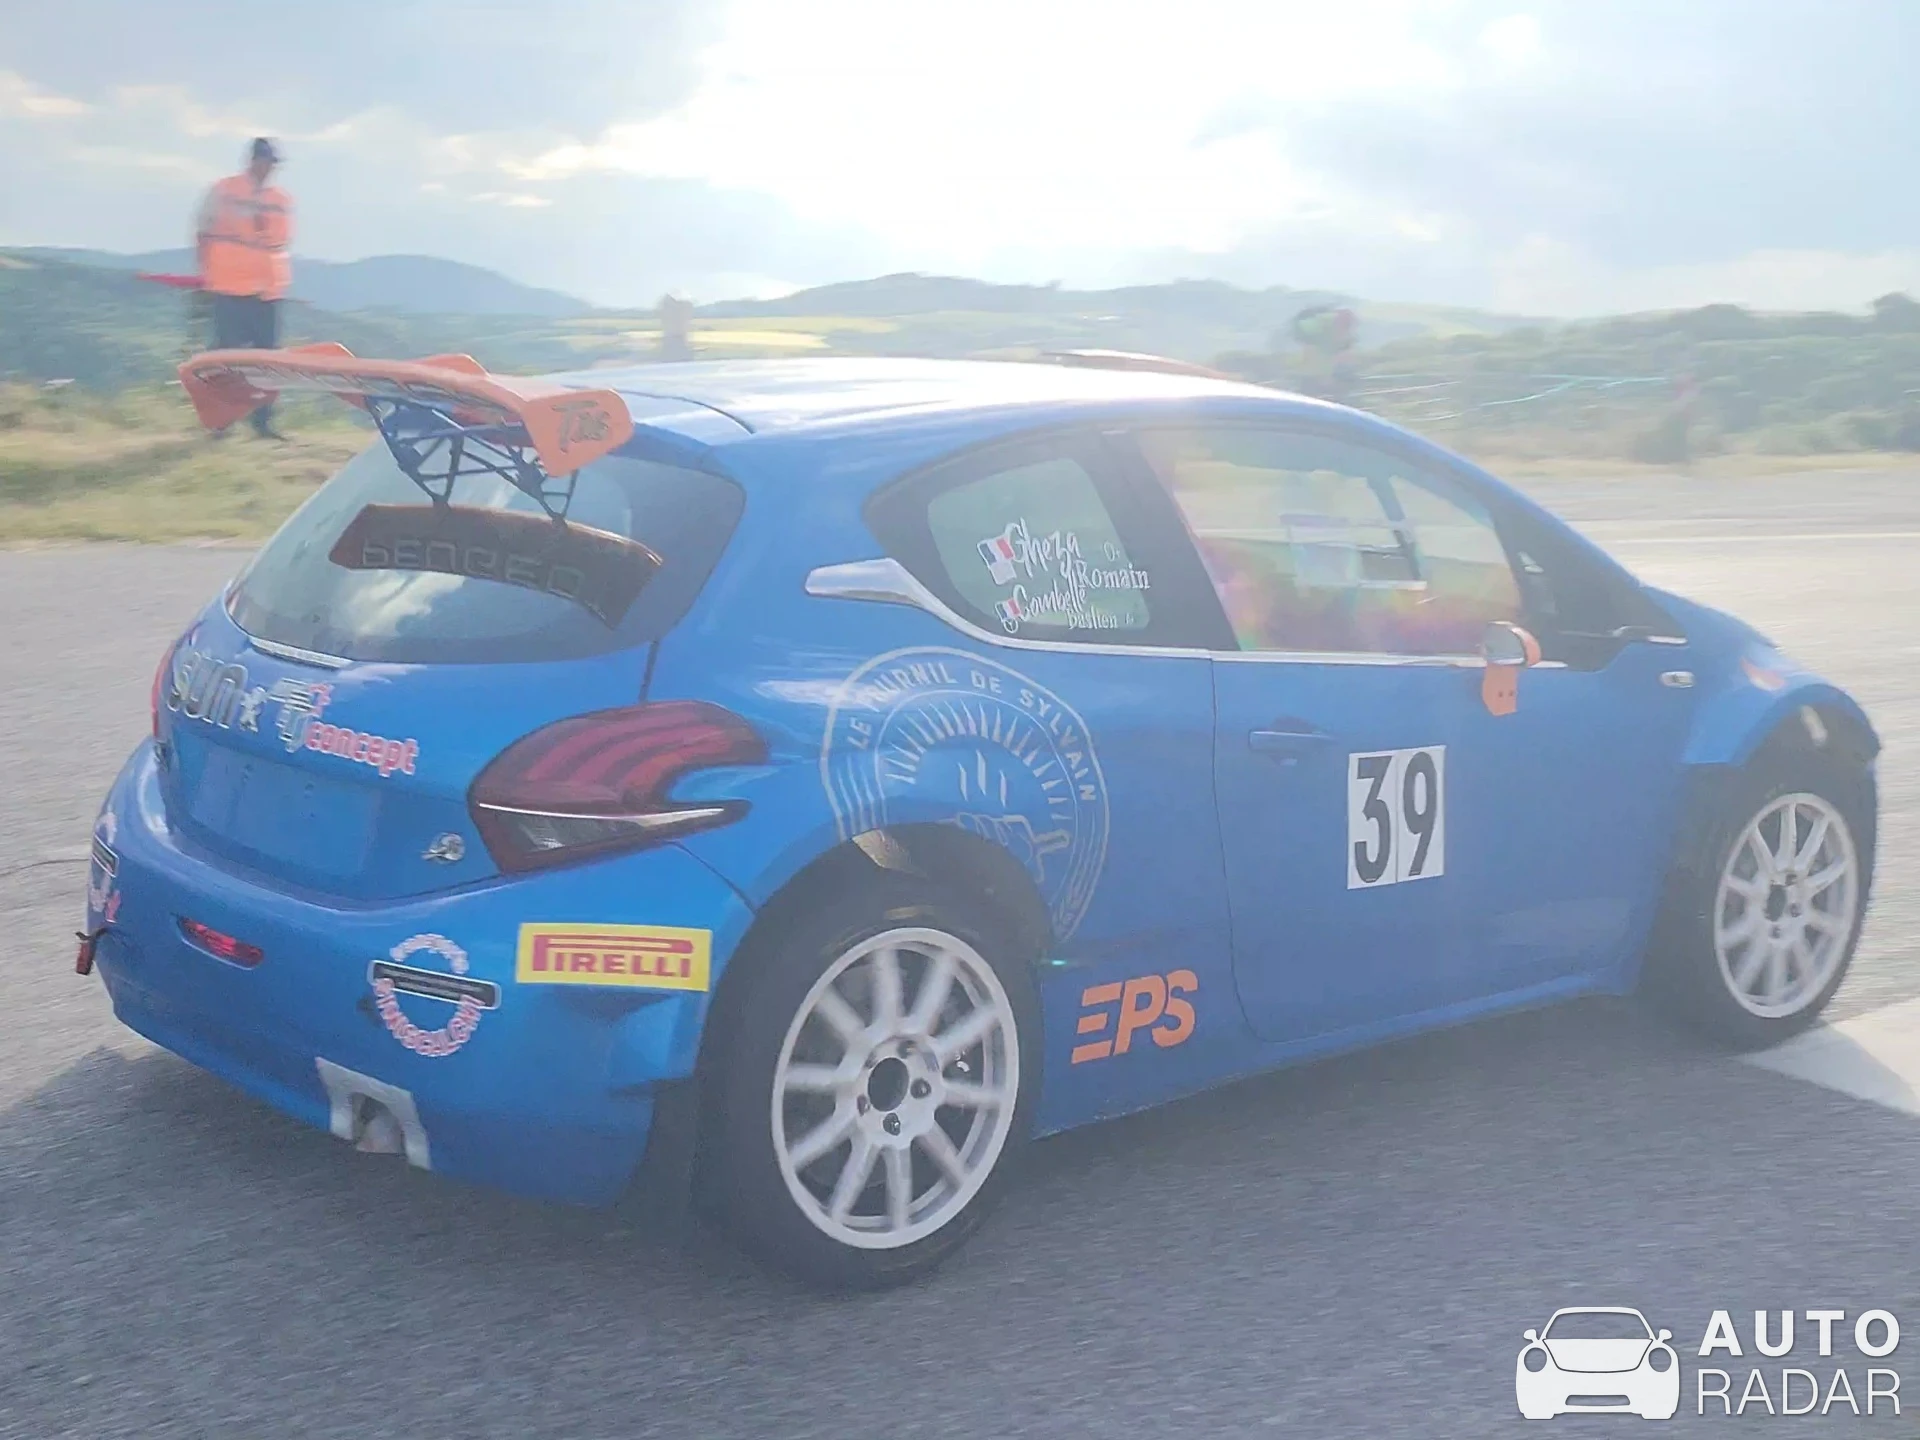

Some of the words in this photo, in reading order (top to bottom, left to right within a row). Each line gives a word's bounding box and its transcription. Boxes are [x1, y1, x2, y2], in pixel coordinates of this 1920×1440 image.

[1074, 560, 1150, 590] Romain
[305, 720, 419, 777] concept
[847, 716, 873, 750] LE
[971, 669, 1002, 695] DE
[1020, 688, 1097, 801] SYLVAIN
[1354, 751, 1438, 884] 39
[533, 935, 693, 978] PIRELLI
[1071, 969, 1199, 1064] EPS
